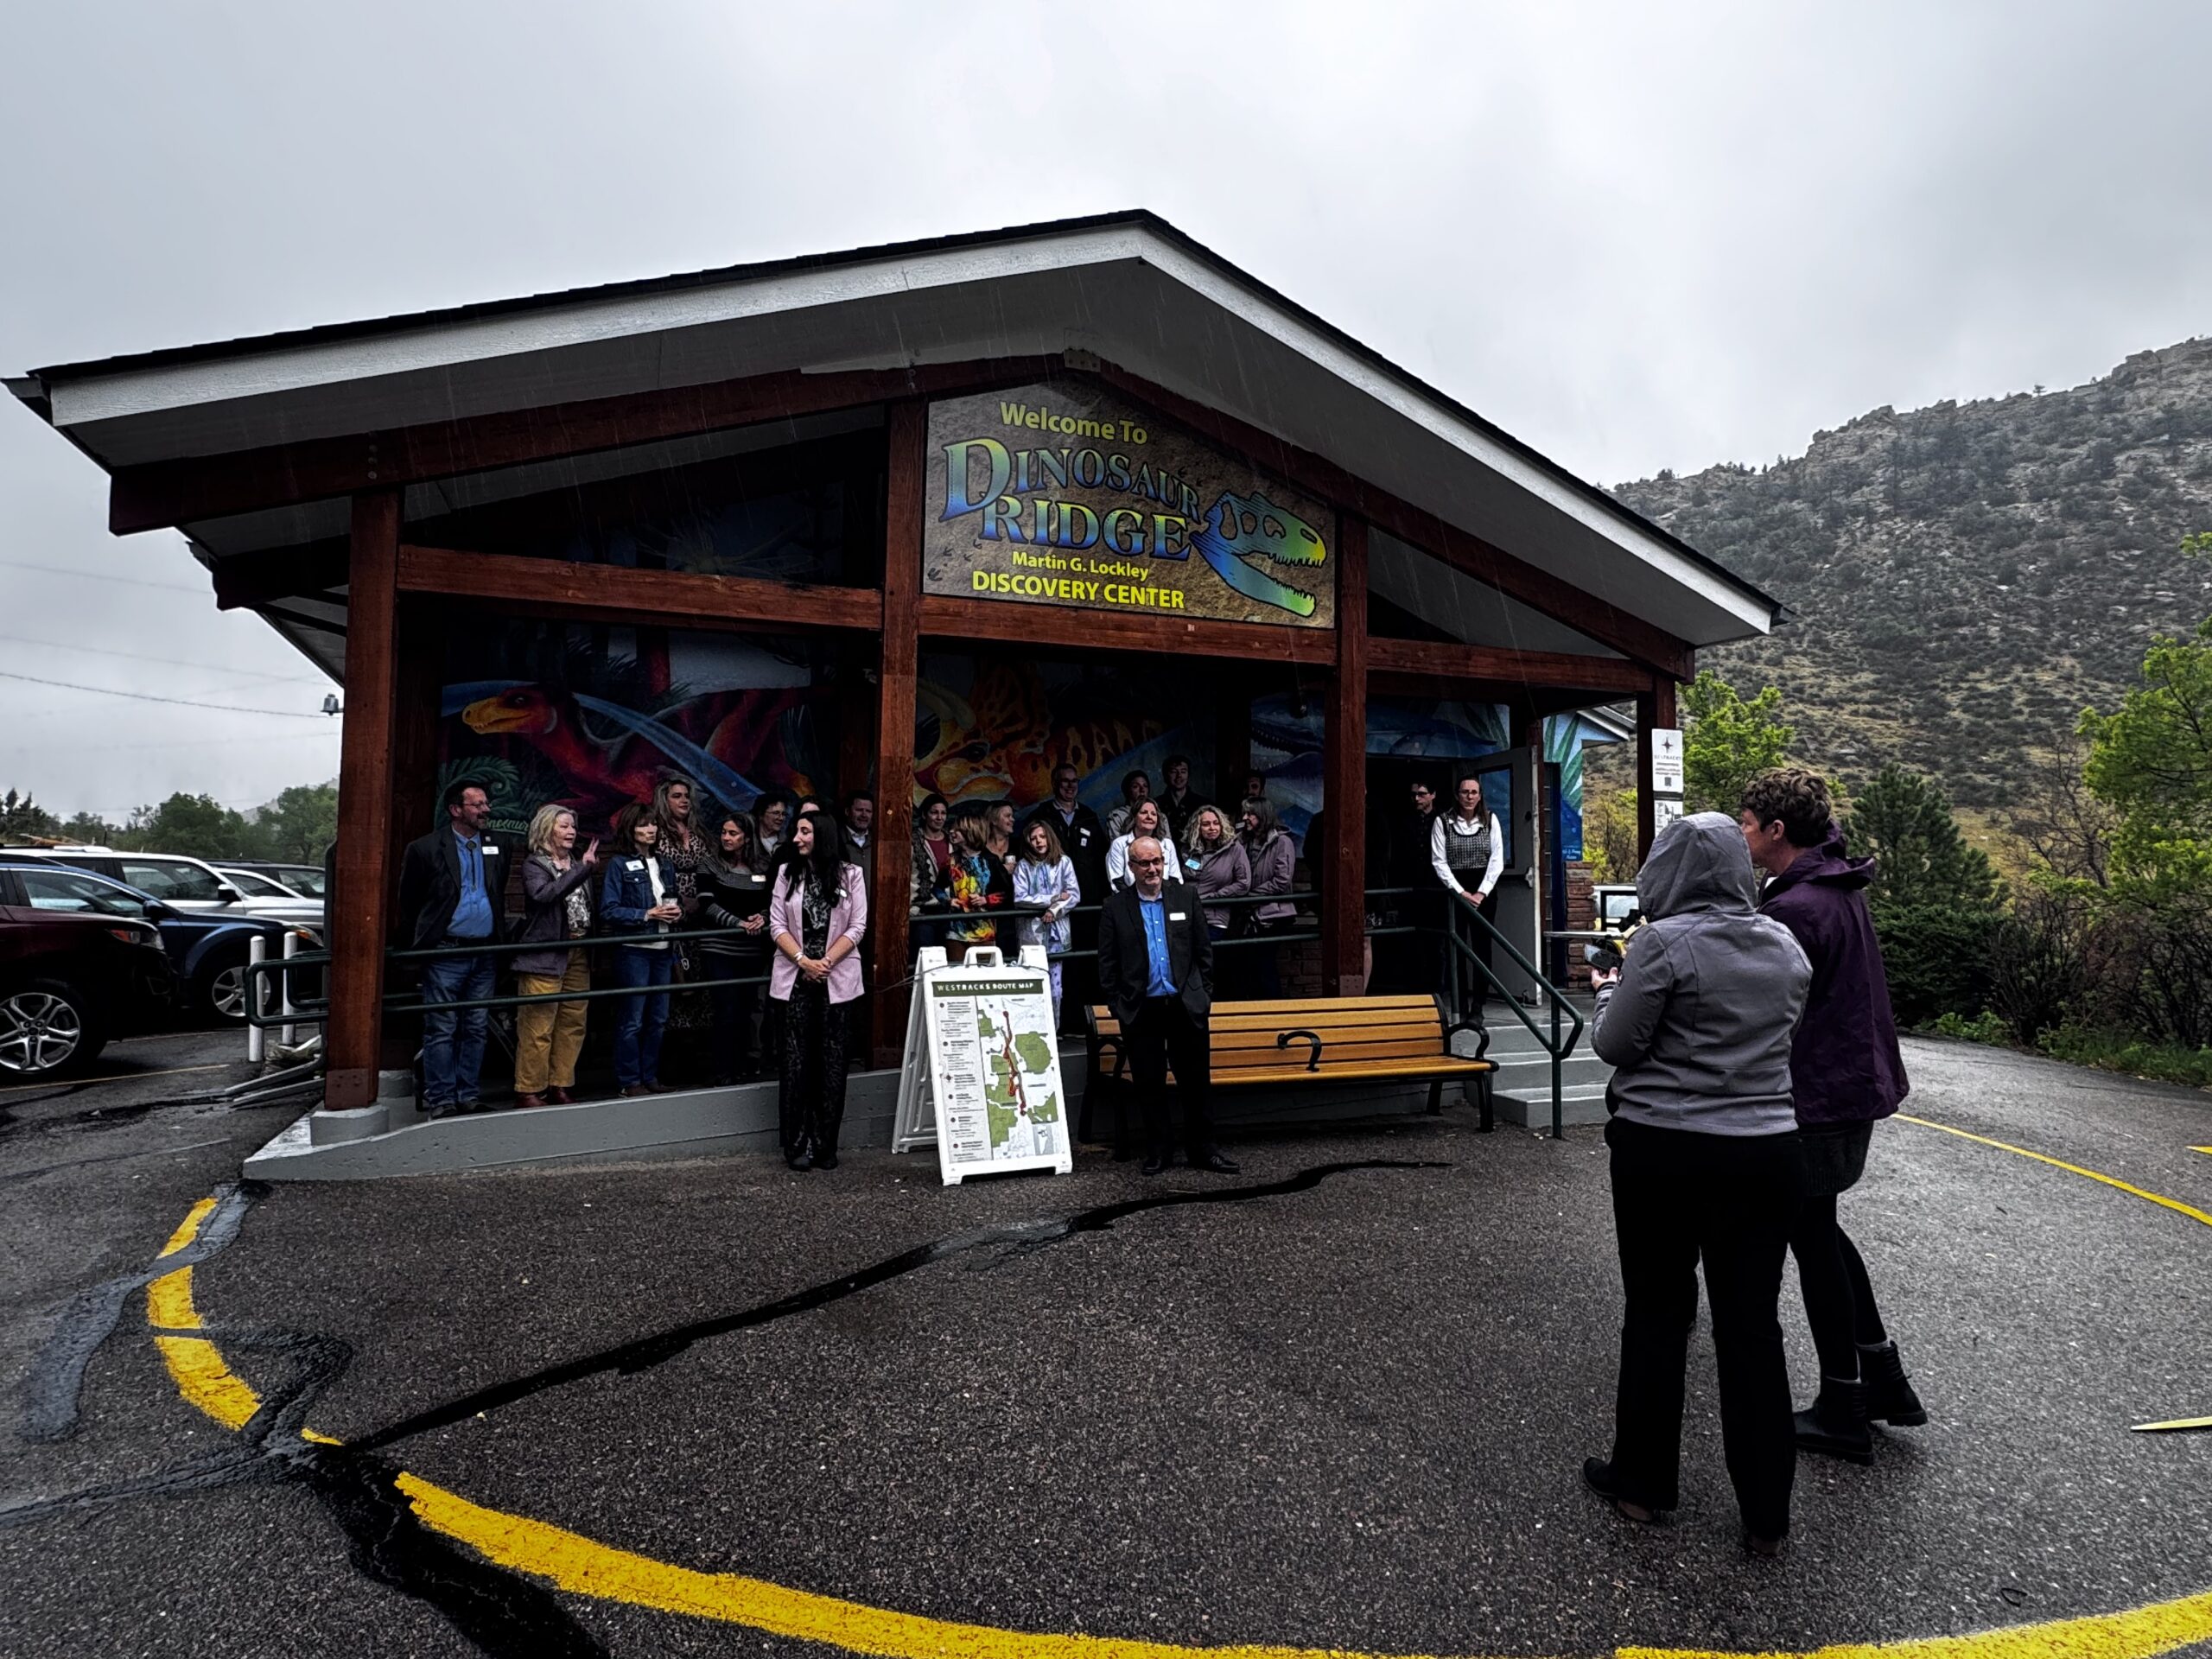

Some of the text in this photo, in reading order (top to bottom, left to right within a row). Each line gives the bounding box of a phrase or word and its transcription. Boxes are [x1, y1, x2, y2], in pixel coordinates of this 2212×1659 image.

[1000, 402, 1147, 444] Welcome To
[938, 437, 1201, 524] DINOSAUR
[978, 494, 1192, 561] RIDGE
[1013, 551, 1148, 582] Martin G. Lockley
[972, 571, 1185, 608] DISCOVERY CENTER
